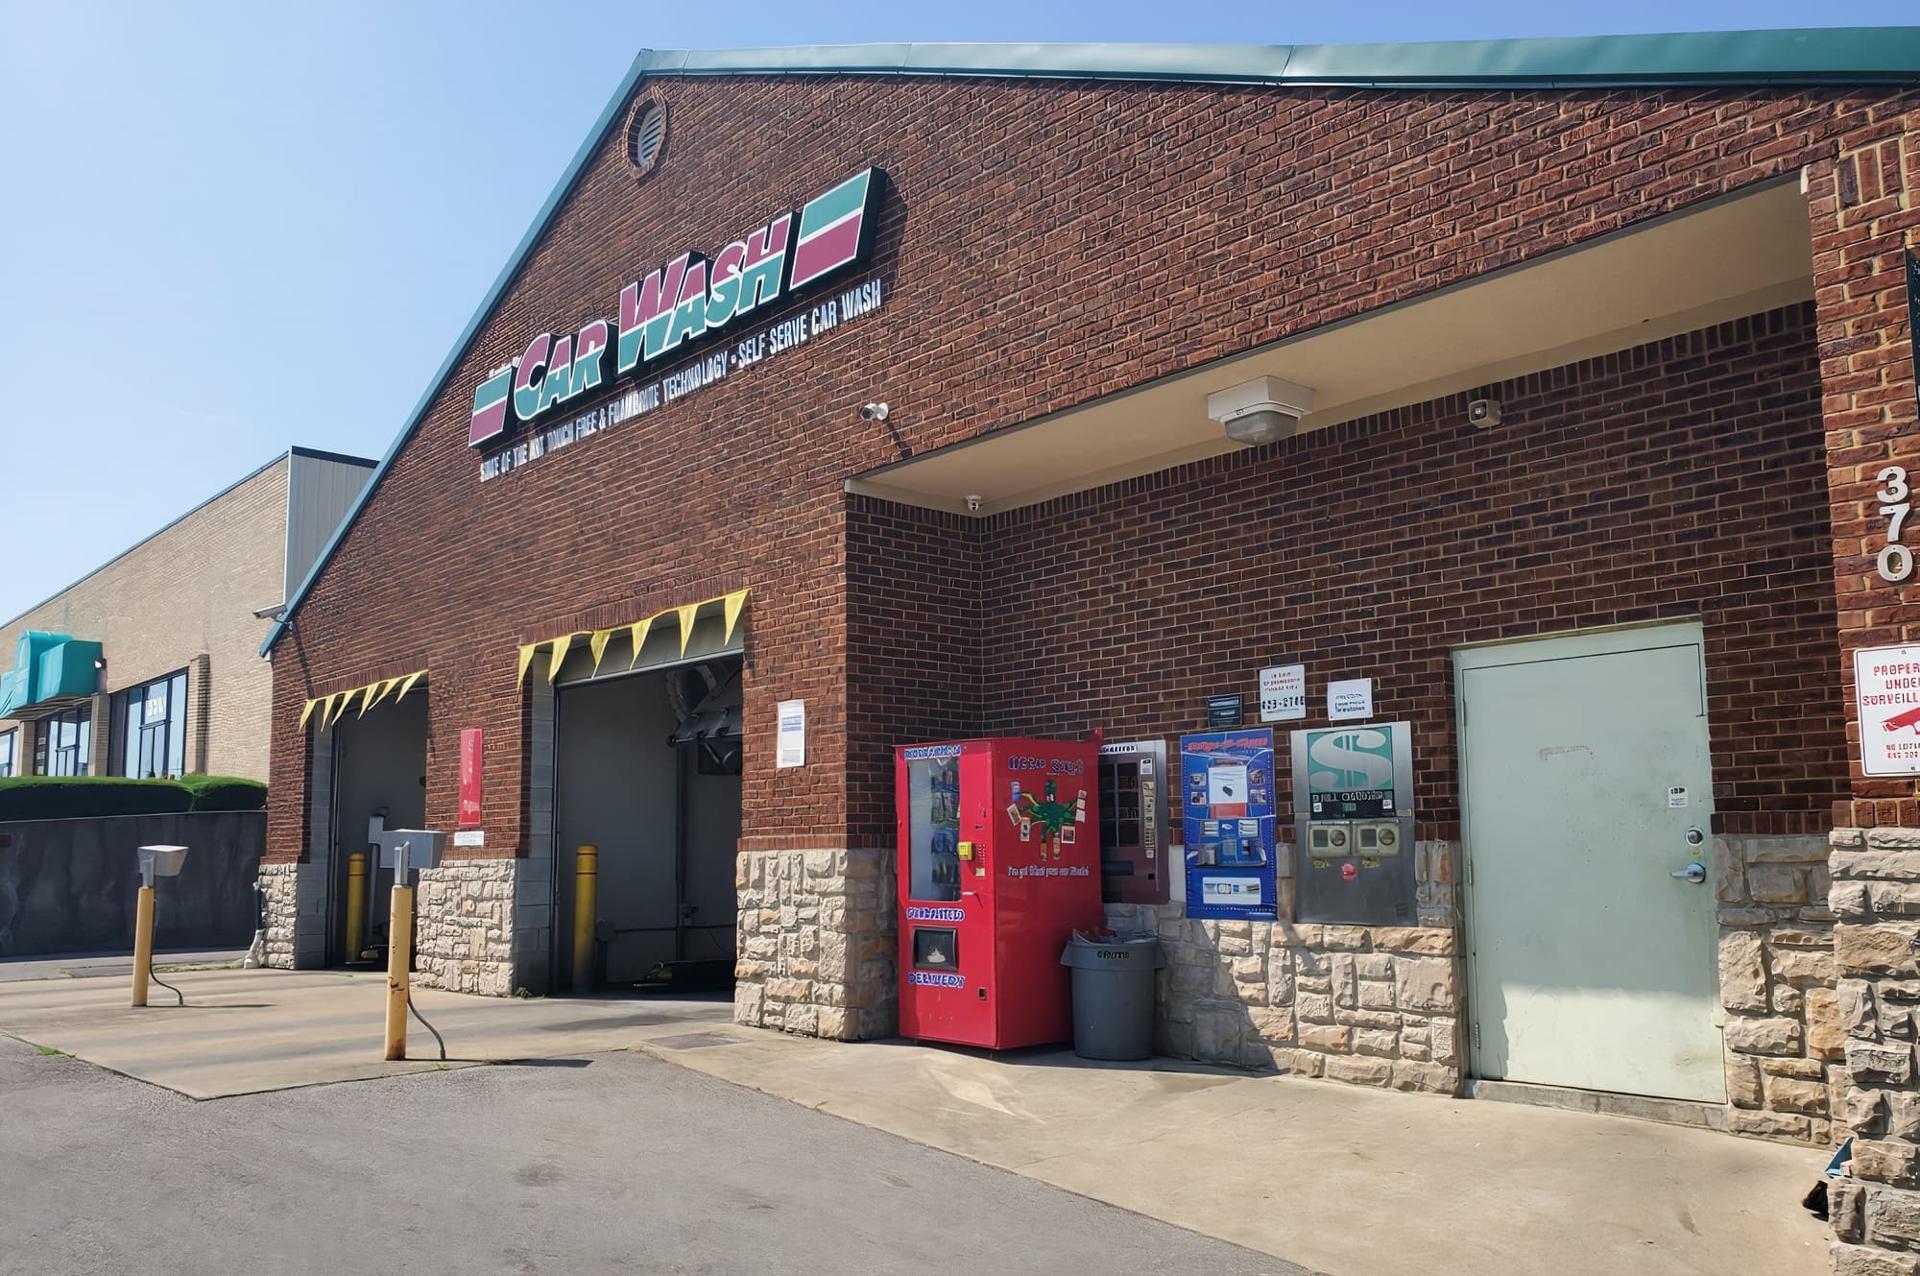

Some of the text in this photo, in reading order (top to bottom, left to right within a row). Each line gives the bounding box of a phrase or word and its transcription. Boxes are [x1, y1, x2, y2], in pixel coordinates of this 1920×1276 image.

[514, 211, 793, 421] CAR WASH
[663, 351, 728, 401] TECHNOLOGY
[738, 331, 766, 368] SELF
[769, 314, 808, 354] SERVE
[811, 301, 837, 335] CAR
[842, 278, 881, 321] WASH
[1877, 466, 1913, 582] 370
